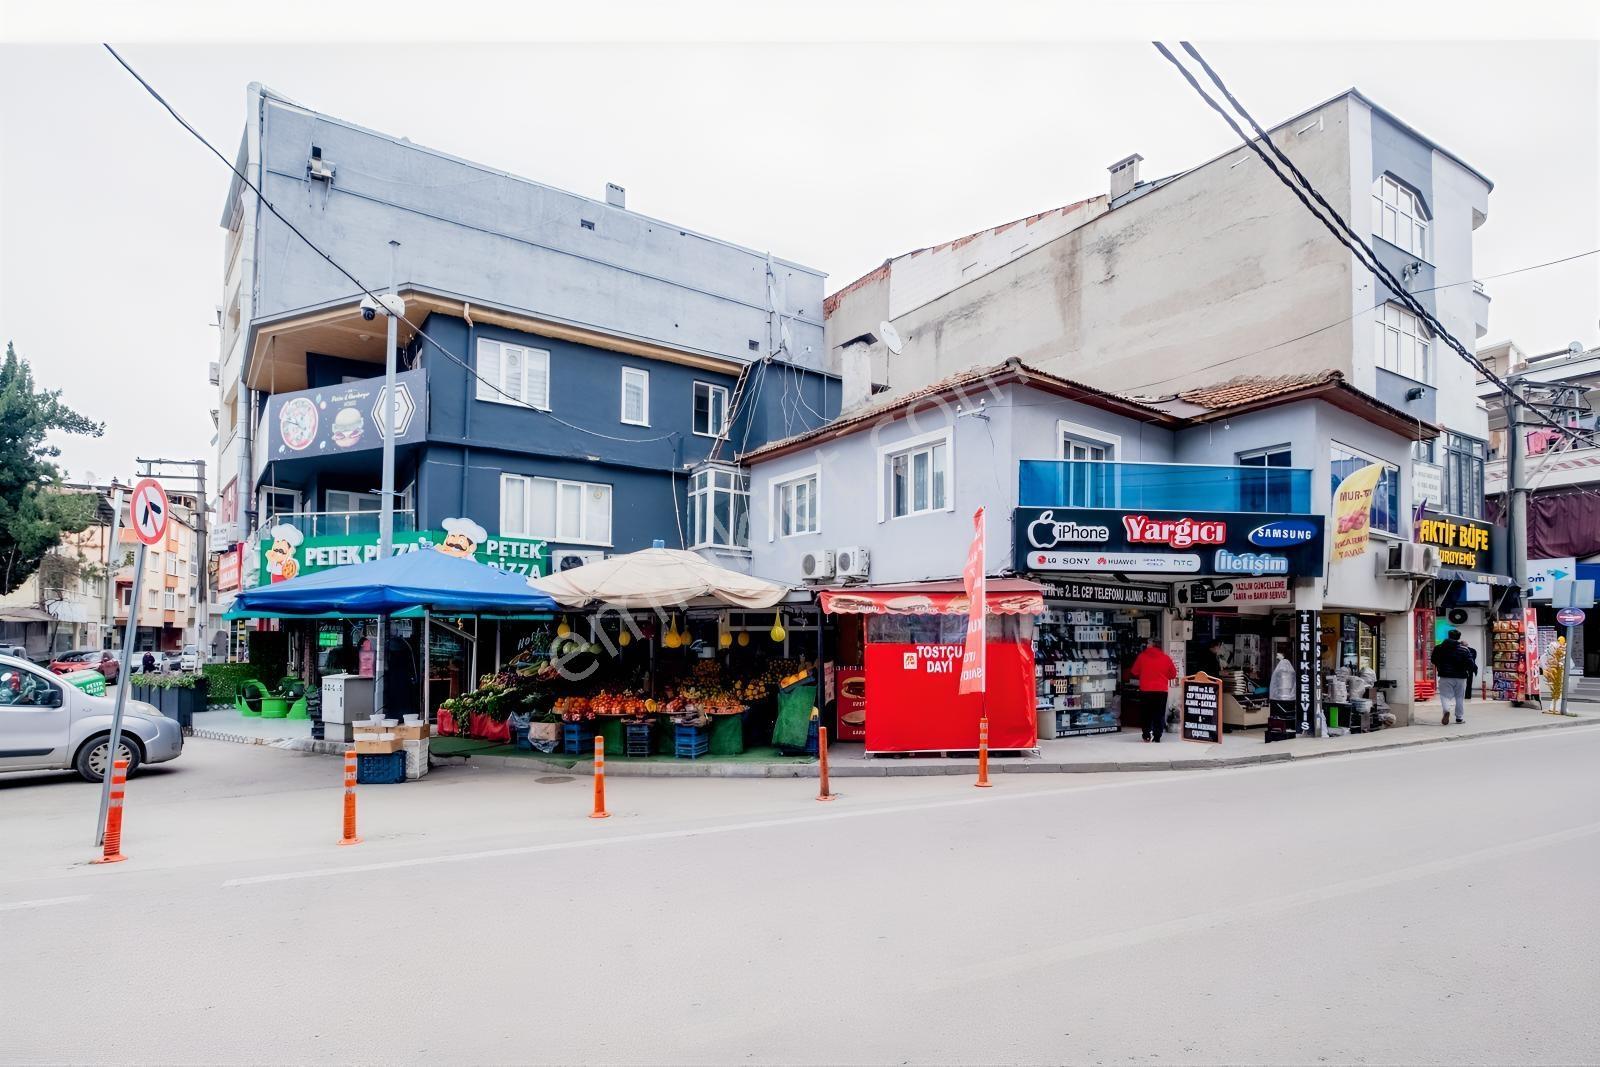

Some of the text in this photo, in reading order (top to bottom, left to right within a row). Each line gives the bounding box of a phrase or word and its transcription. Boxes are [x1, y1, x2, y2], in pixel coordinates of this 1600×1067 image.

[1058, 525, 1107, 539] iPhone
[1257, 528, 1312, 540] SAMSUNG
[1459, 524, 1489, 551] BÜFE
[305, 538, 419, 566] PETEK PİZ
[486, 540, 541, 559] PETEK
[1065, 584, 1071, 597] 2.
[1072, 585, 1080, 598] EL
[1082, 586, 1094, 598] CEP
[1094, 587, 1124, 600] TELEFONU
[916, 646, 963, 661] TOSTÇU
